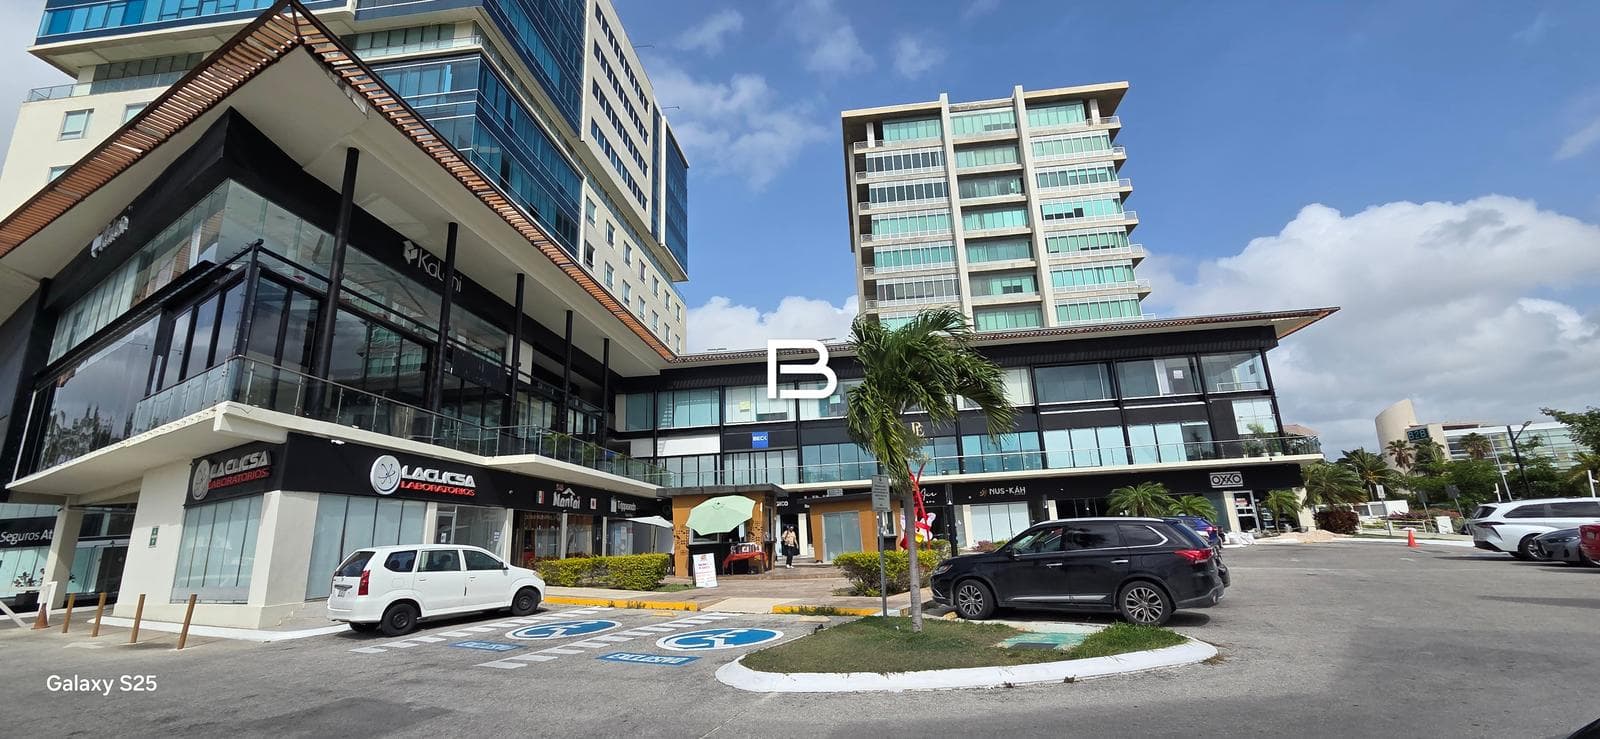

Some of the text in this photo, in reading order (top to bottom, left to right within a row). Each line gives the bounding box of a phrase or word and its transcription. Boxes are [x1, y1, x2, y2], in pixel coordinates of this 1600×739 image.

[417, 249, 462, 293] Kalni
[209, 451, 272, 479] LACLICSA
[401, 465, 476, 488] LACLICSA
[1211, 474, 1242, 486] OXXO
[400, 481, 475, 497] LABORATORIOS
[0, 531, 40, 545] Seguros
